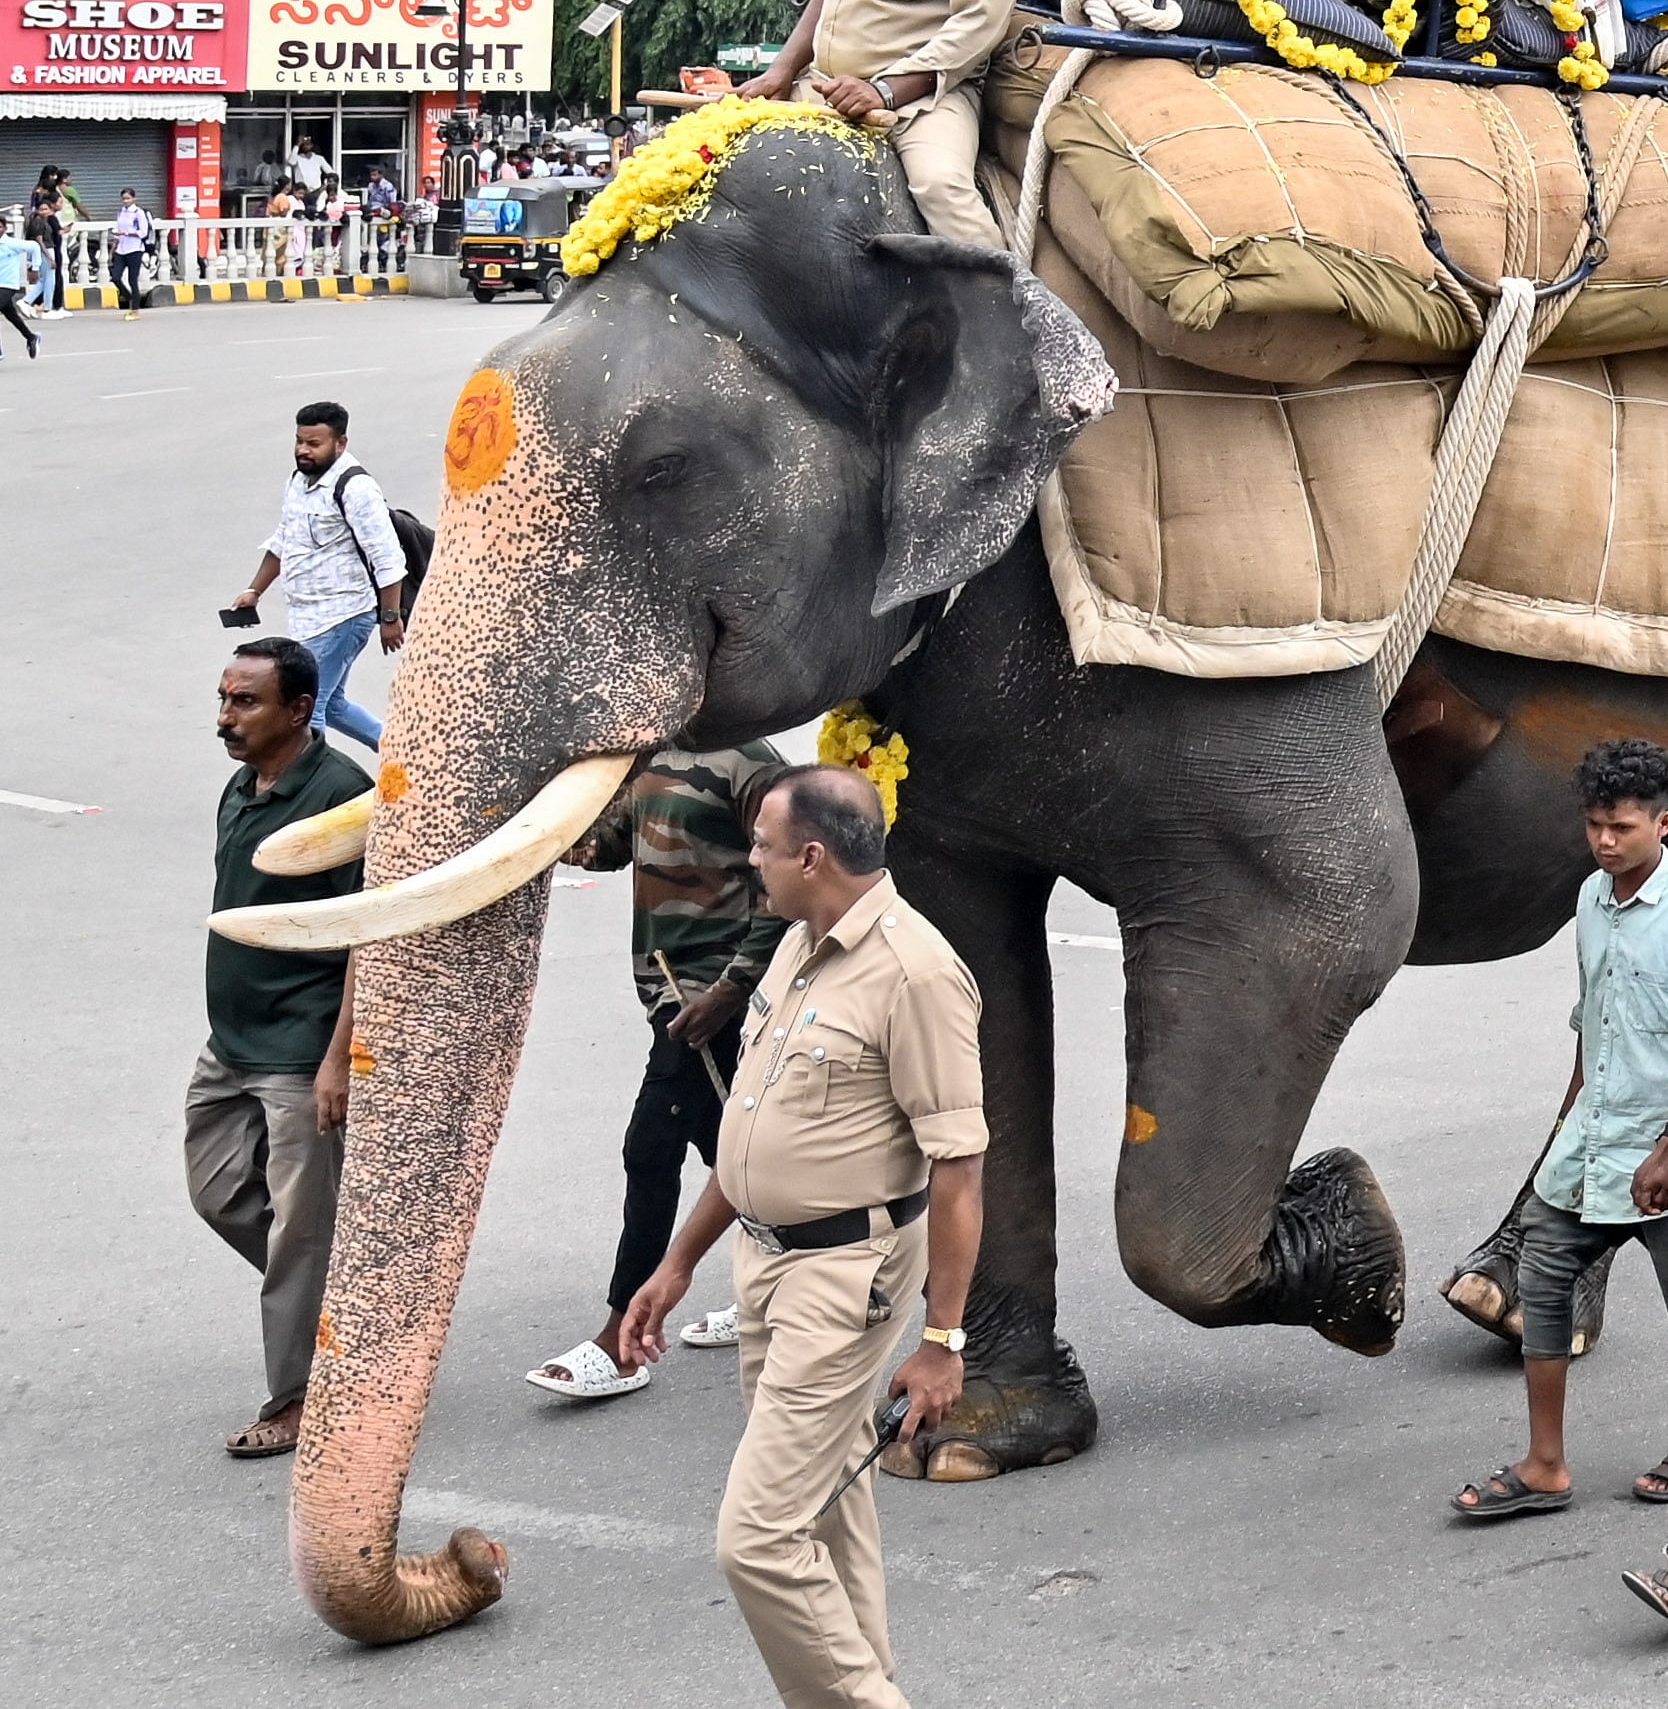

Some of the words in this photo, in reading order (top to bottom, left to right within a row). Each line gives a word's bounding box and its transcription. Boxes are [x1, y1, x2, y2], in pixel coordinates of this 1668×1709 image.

[22, 0, 225, 30] SHOE
[48, 34, 194, 61] MUSEUM
[278, 41, 524, 71] SUNLIGHT
[11, 66, 28, 84] &
[35, 66, 126, 84] FASHION
[132, 67, 228, 85] APPAREL
[276, 71, 404, 84] CLEANERS
[423, 71, 433, 84] &
[448, 71, 524, 84] DYERS
